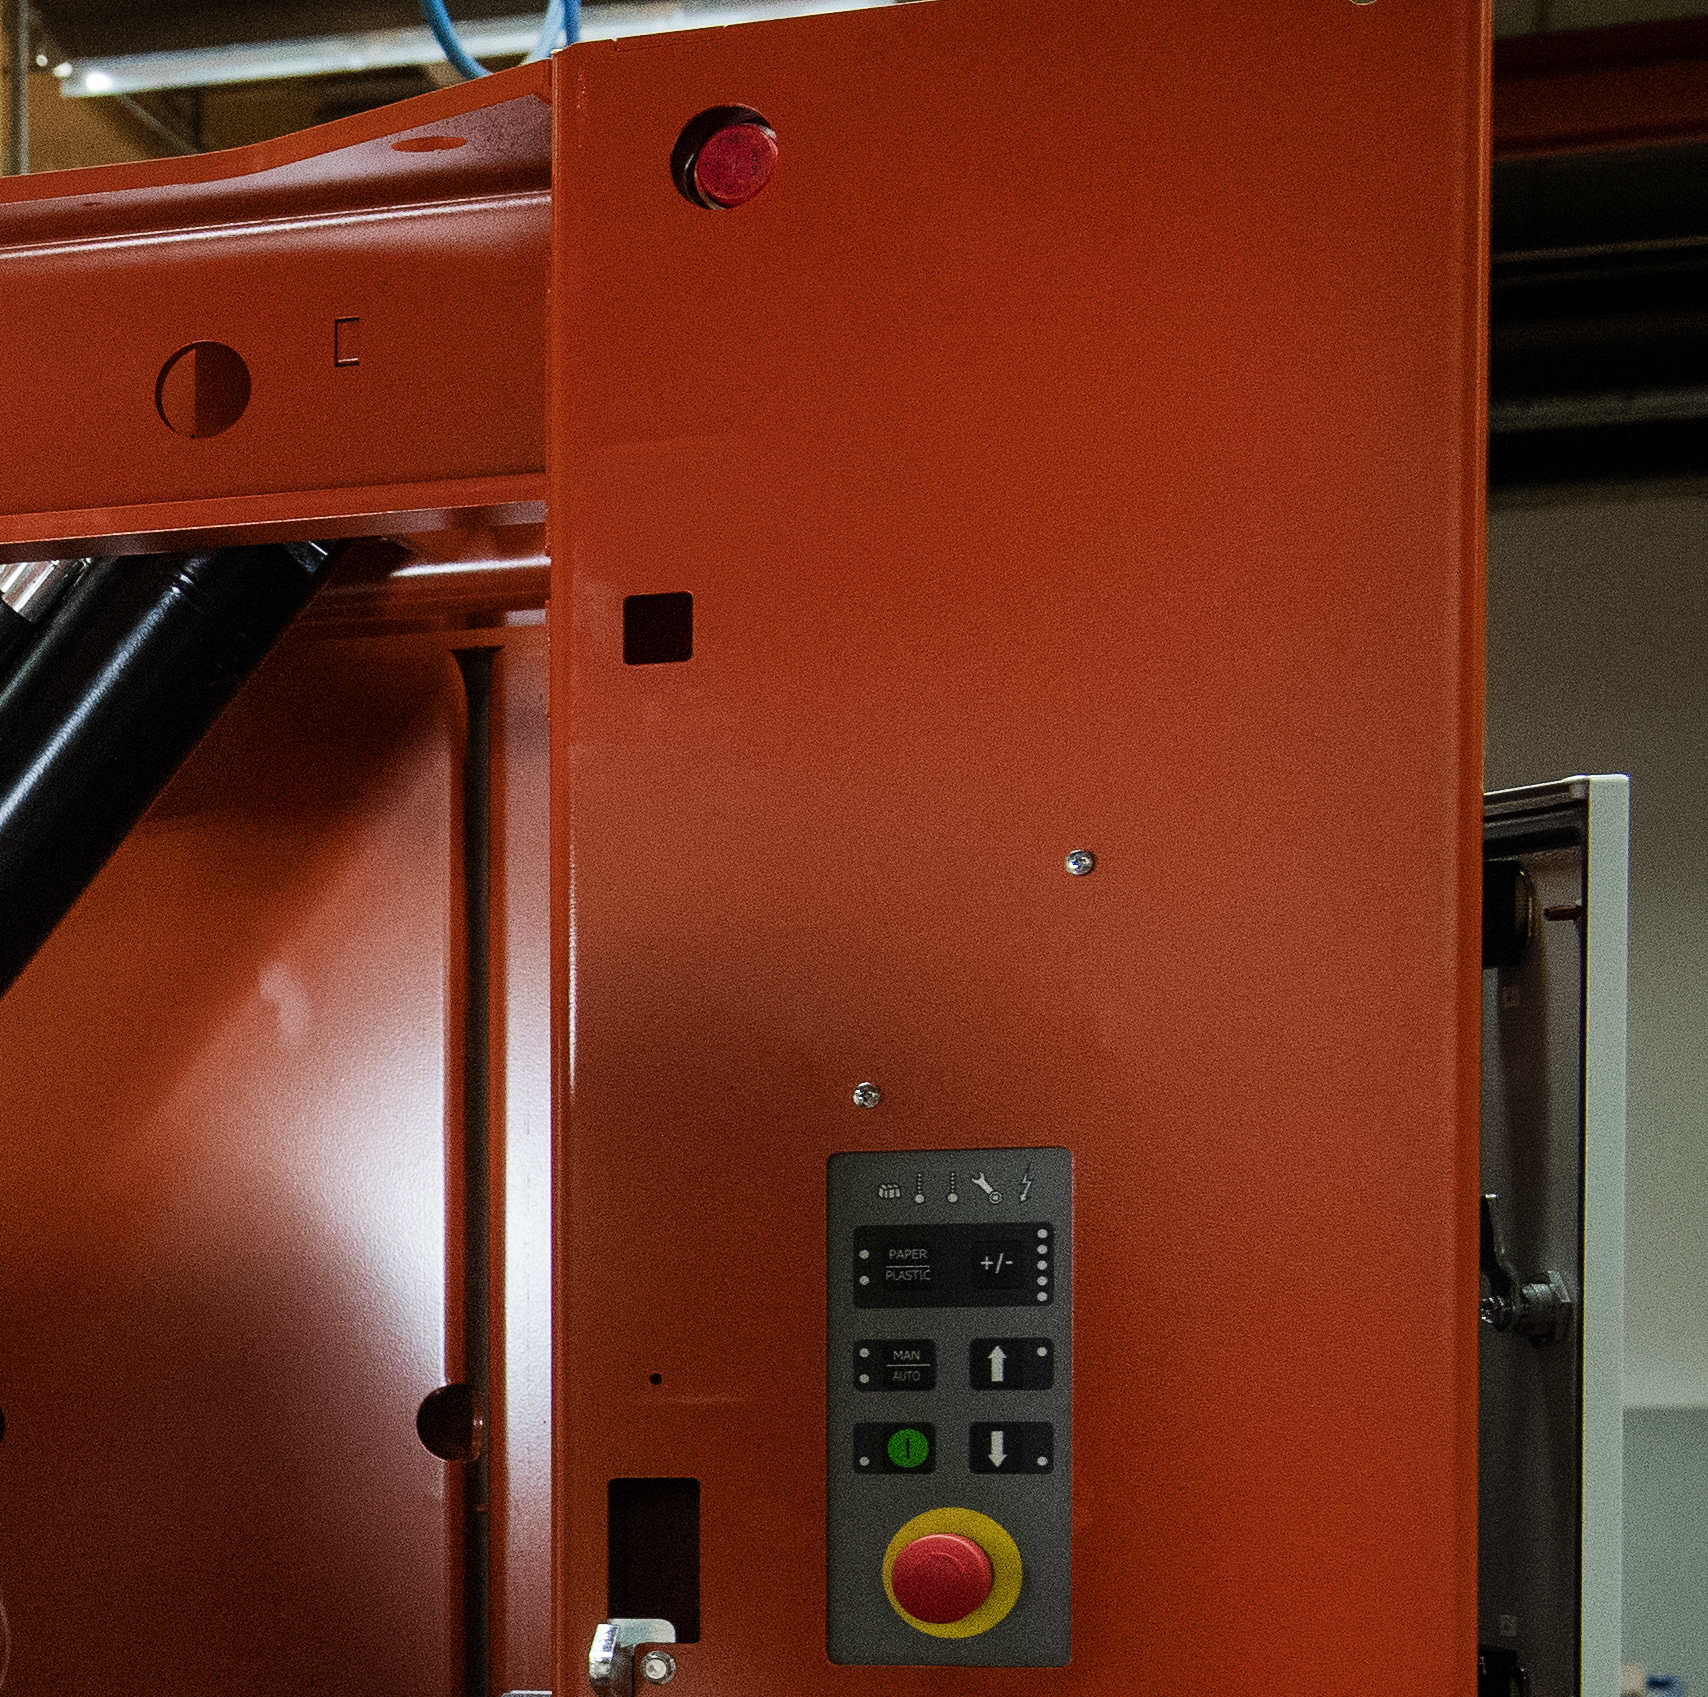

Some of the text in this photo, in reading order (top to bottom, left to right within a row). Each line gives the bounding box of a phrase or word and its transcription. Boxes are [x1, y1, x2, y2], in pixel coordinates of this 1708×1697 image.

[888, 1248, 929, 1260] PAPER
[885, 1269, 932, 1281] PLASTIC
[892, 1350, 922, 1361] MAN
[892, 1370, 922, 1382] AUTO
